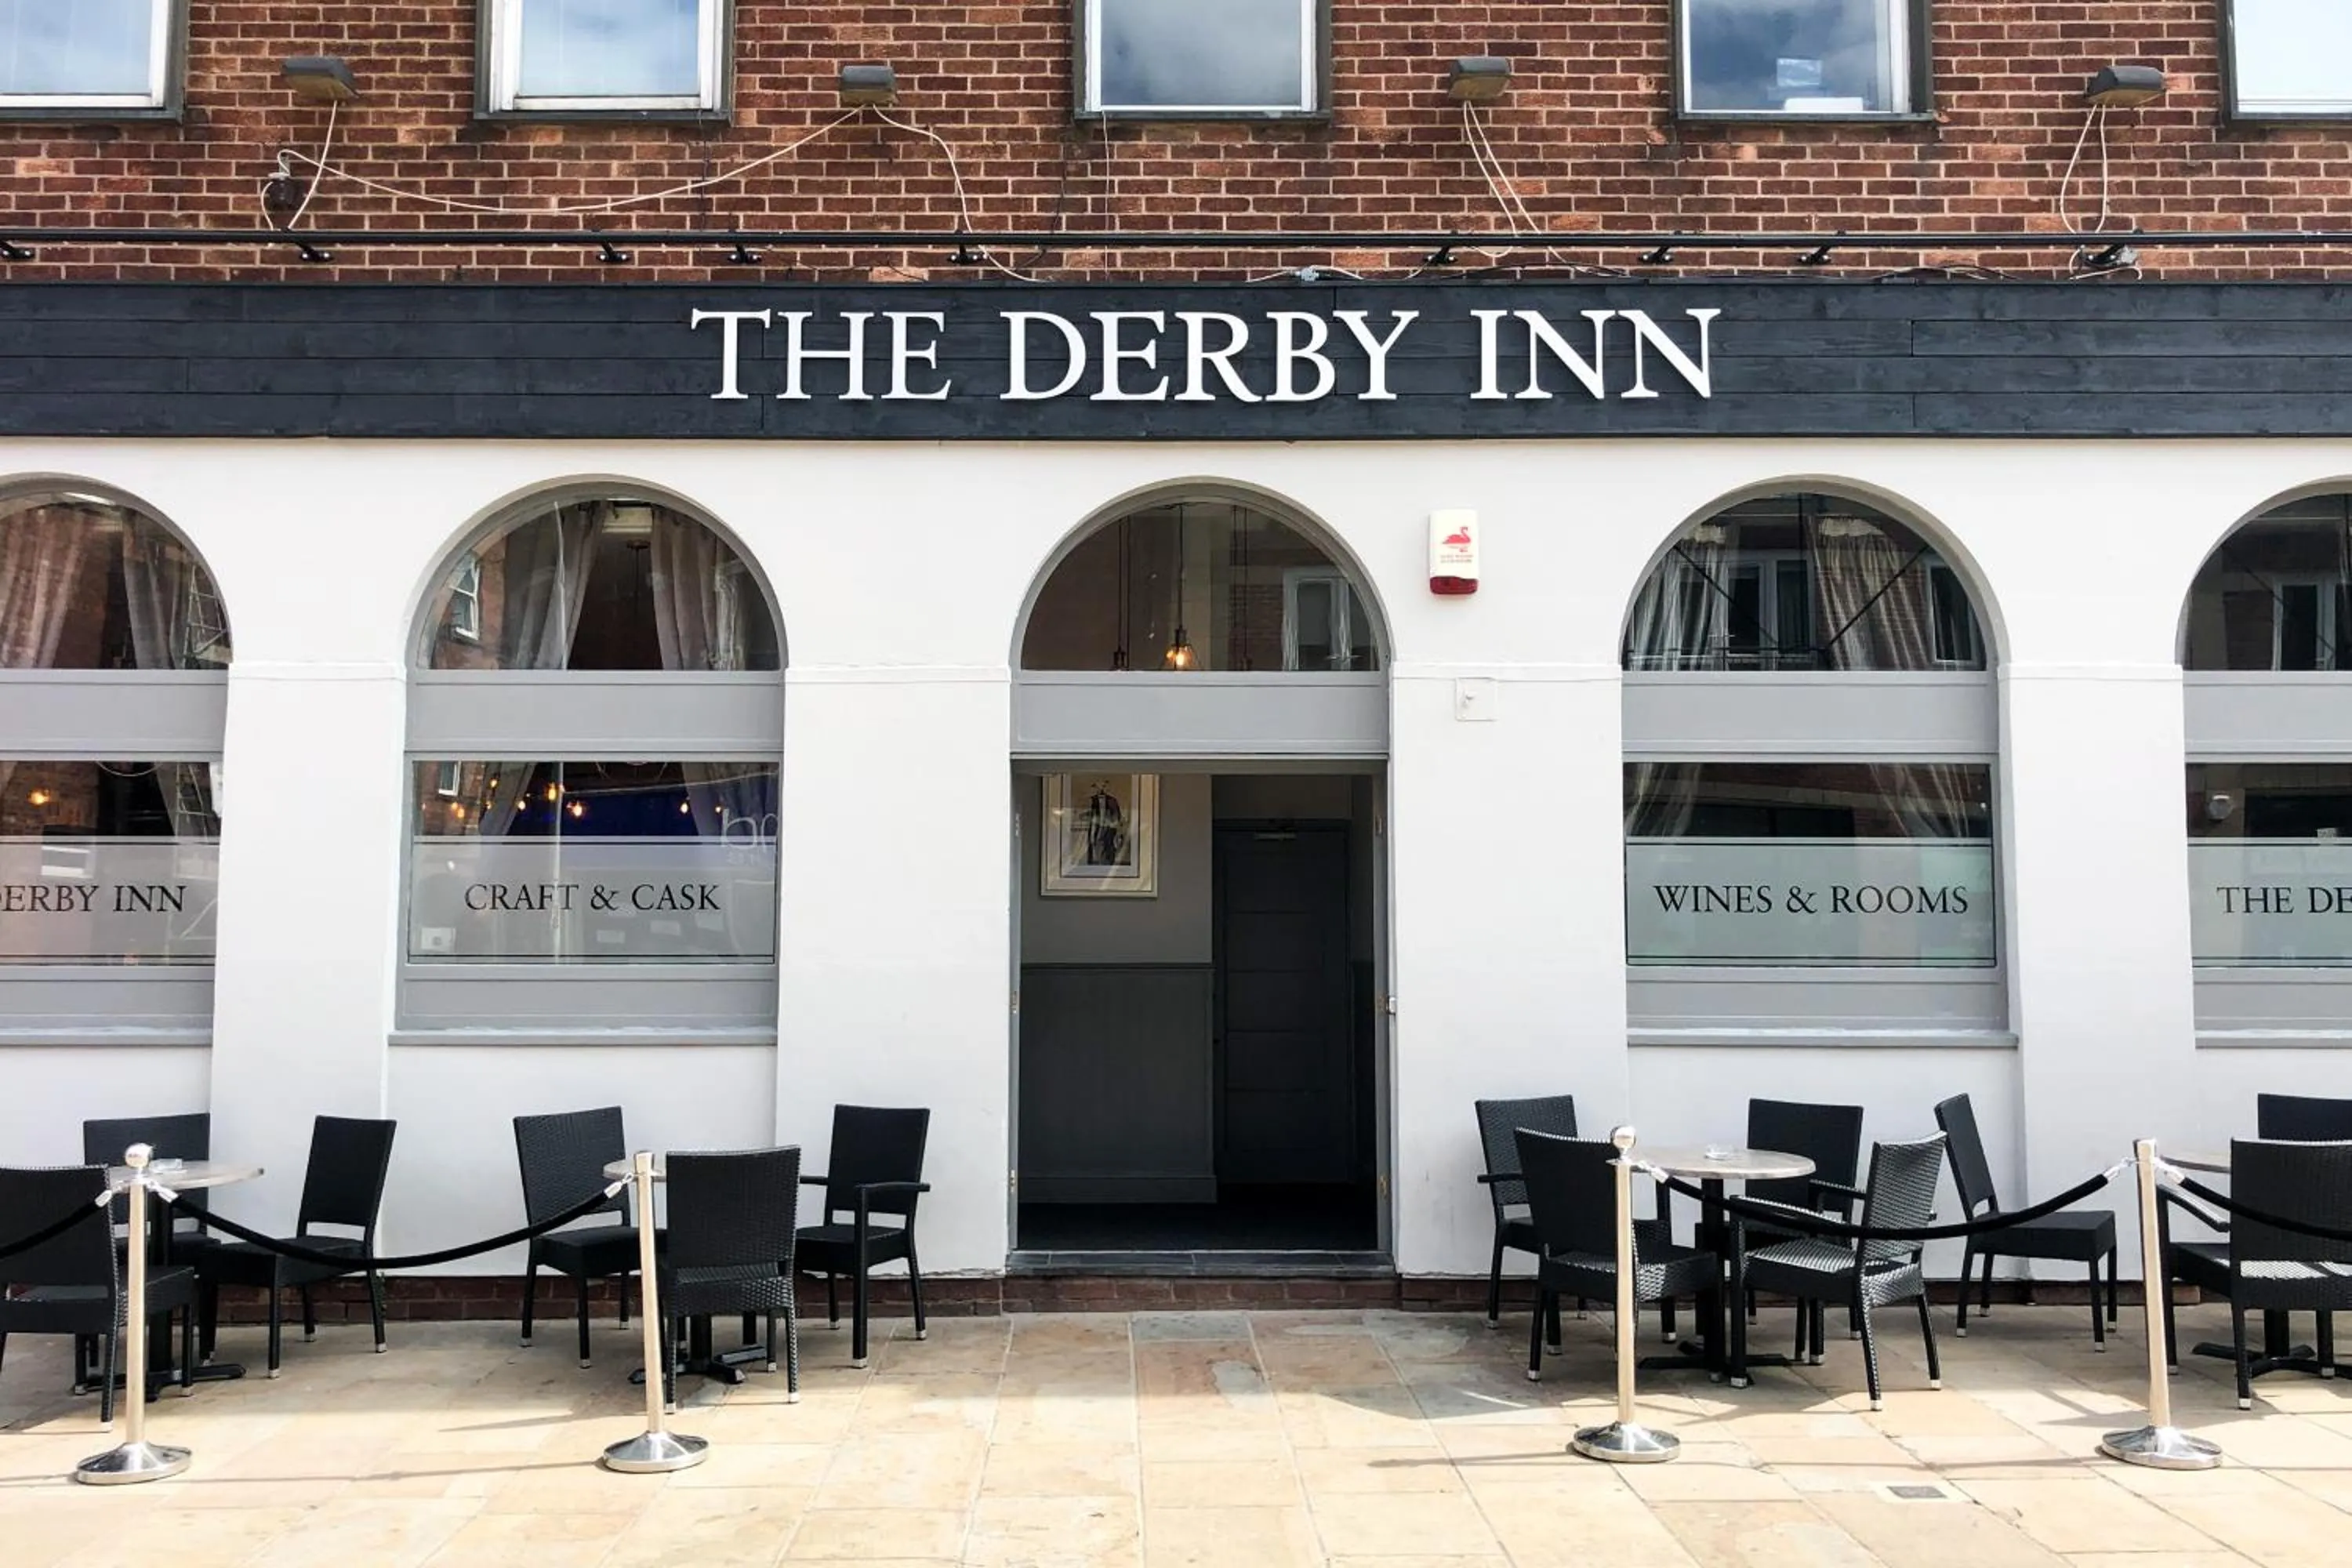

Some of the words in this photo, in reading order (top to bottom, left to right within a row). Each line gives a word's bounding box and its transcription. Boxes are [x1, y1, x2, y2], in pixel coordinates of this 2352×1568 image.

[691, 308, 952, 400] THE
[1000, 309, 1420, 402] DERBY
[1470, 308, 1722, 400] INN
[0, 885, 100, 912] ERBY
[112, 885, 187, 912] INN
[464, 884, 579, 911] CRAFT
[590, 884, 619, 911] &
[631, 884, 721, 911] CASK
[1652, 884, 1773, 914] WINES
[1786, 885, 1818, 914] &
[1830, 885, 1969, 914] ROOMS
[2216, 887, 2295, 914] THE
